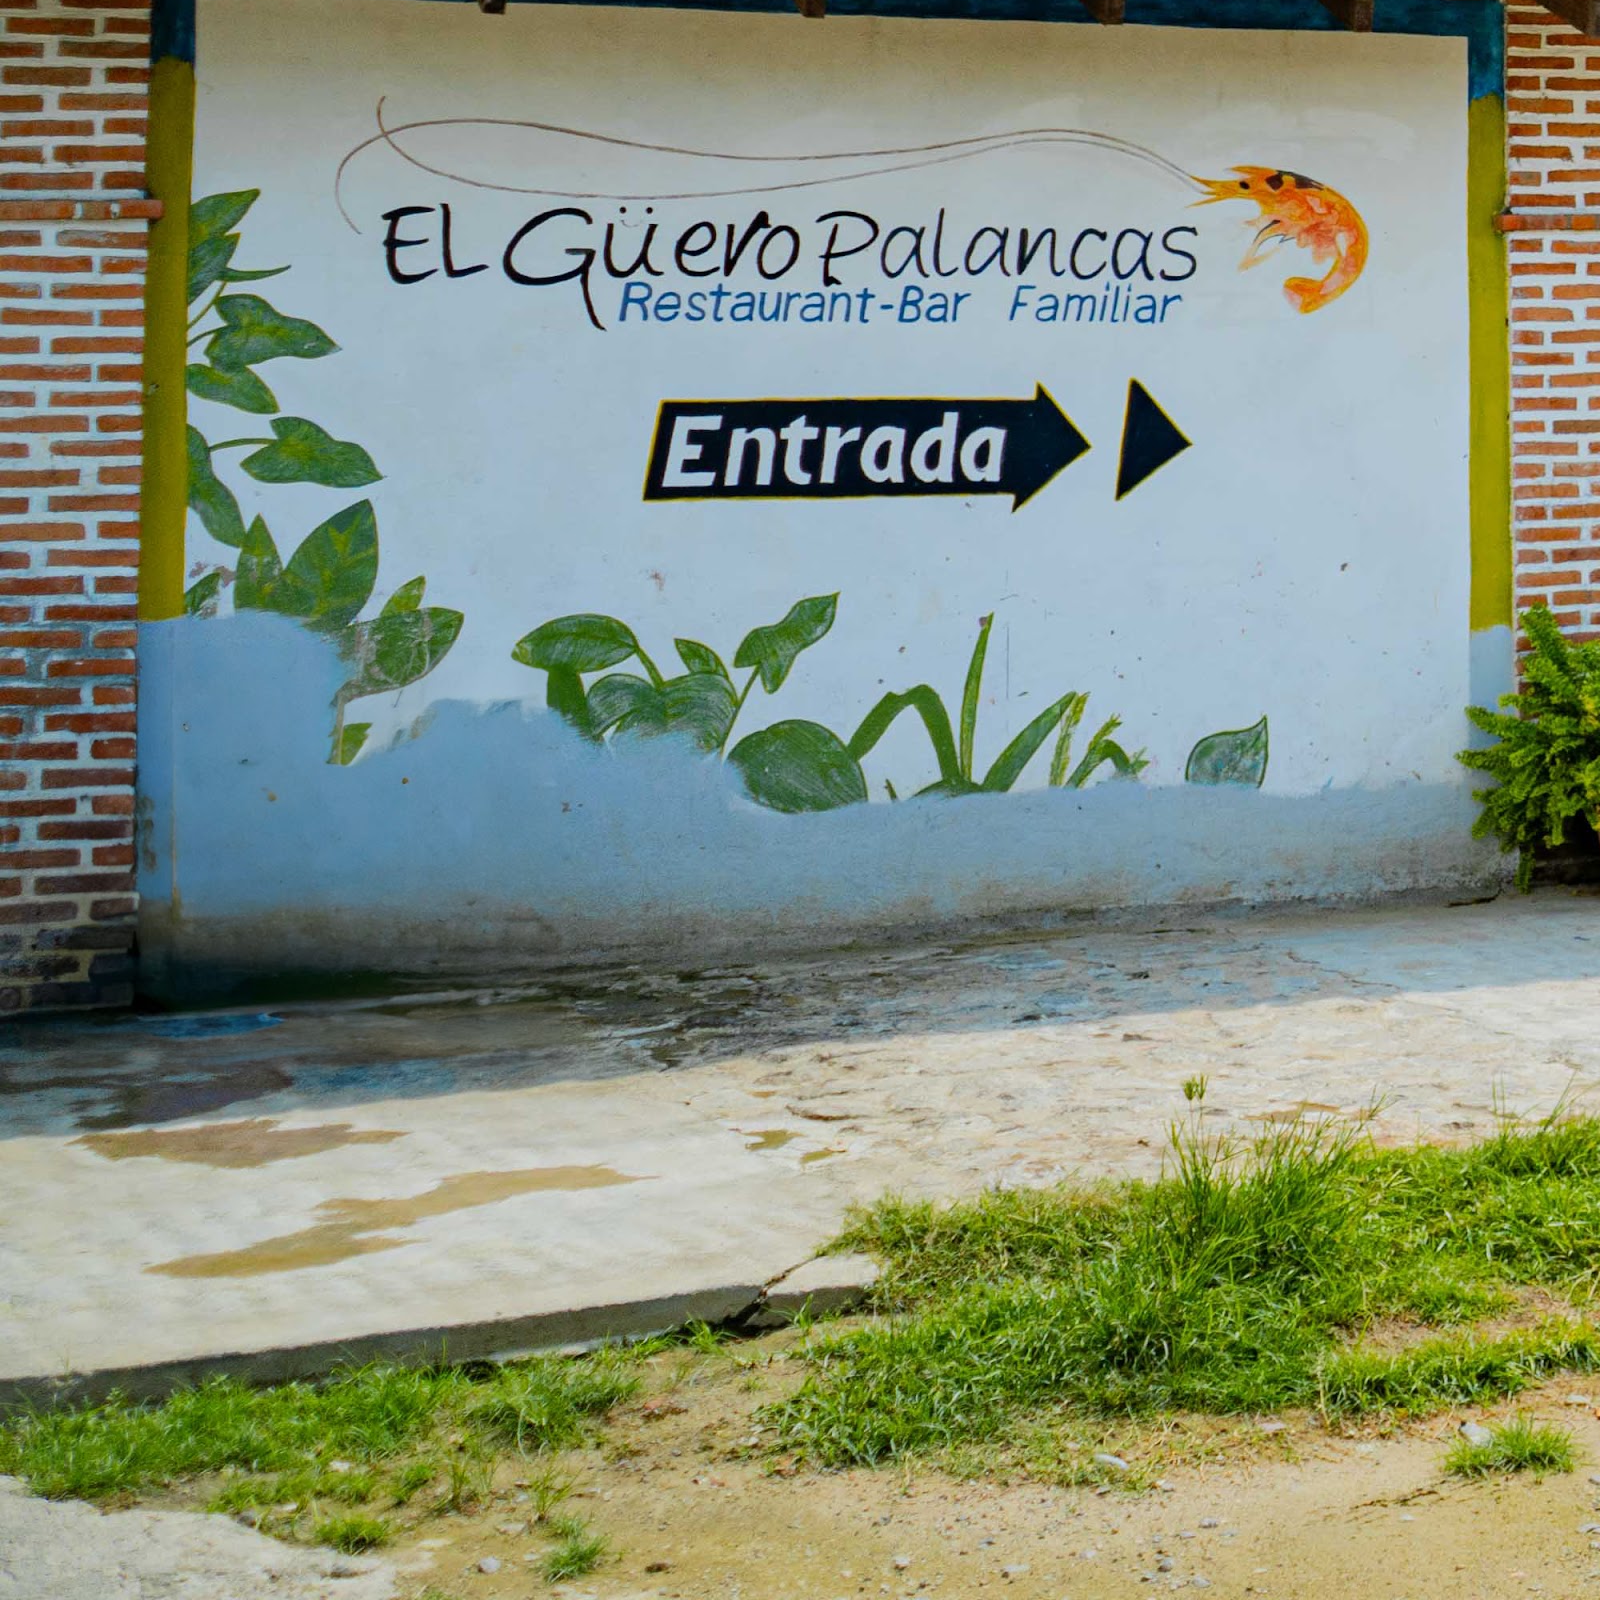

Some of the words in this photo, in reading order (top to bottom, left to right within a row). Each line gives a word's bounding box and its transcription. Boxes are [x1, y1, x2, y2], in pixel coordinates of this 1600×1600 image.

[503, 205, 800, 331] Güero
[816, 208, 1200, 287] Palancas
[1009, 284, 1184, 325] Familiar
[662, 413, 1008, 488] Entrada
